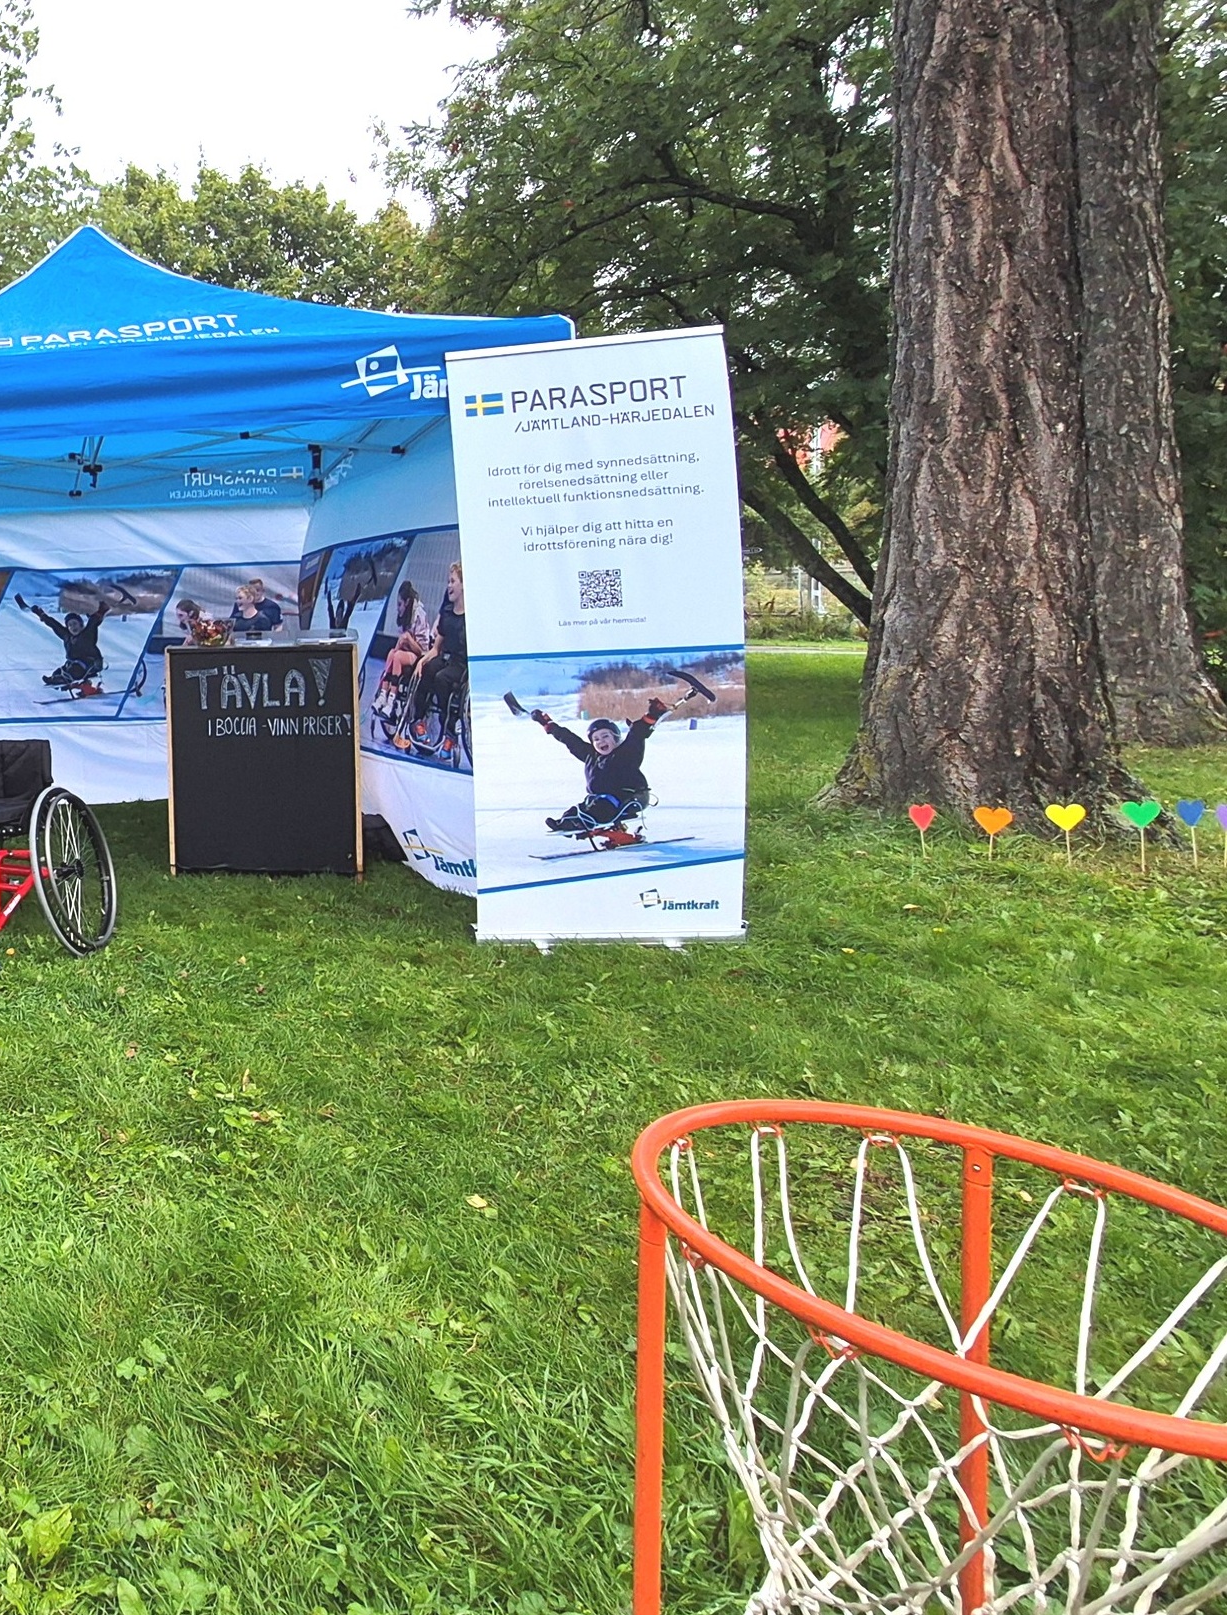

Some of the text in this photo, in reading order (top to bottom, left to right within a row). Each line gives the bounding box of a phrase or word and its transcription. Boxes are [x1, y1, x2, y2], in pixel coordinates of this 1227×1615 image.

[21, 314, 238, 347] PARASPORT
[511, 375, 687, 413] PARASPORT
[514, 404, 715, 433] /JÄMTLAND-HÄRJEDALEN
[488, 452, 700, 477] Idrott för dig med synnedsättning,
[519, 470, 669, 490] rörelsenedsättning eller
[488, 484, 704, 507] intellektuell funktionsnedsättning.
[521, 517, 673, 537] Vi hjälper dig att hitta en
[524, 533, 673, 552] idrottsförening nära dig!
[184, 658, 332, 710] TÄVLA!
[215, 716, 257, 737] BOCCIA
[302, 714, 351, 736] PRISER!
[662, 899, 720, 910] Jämtkraft
